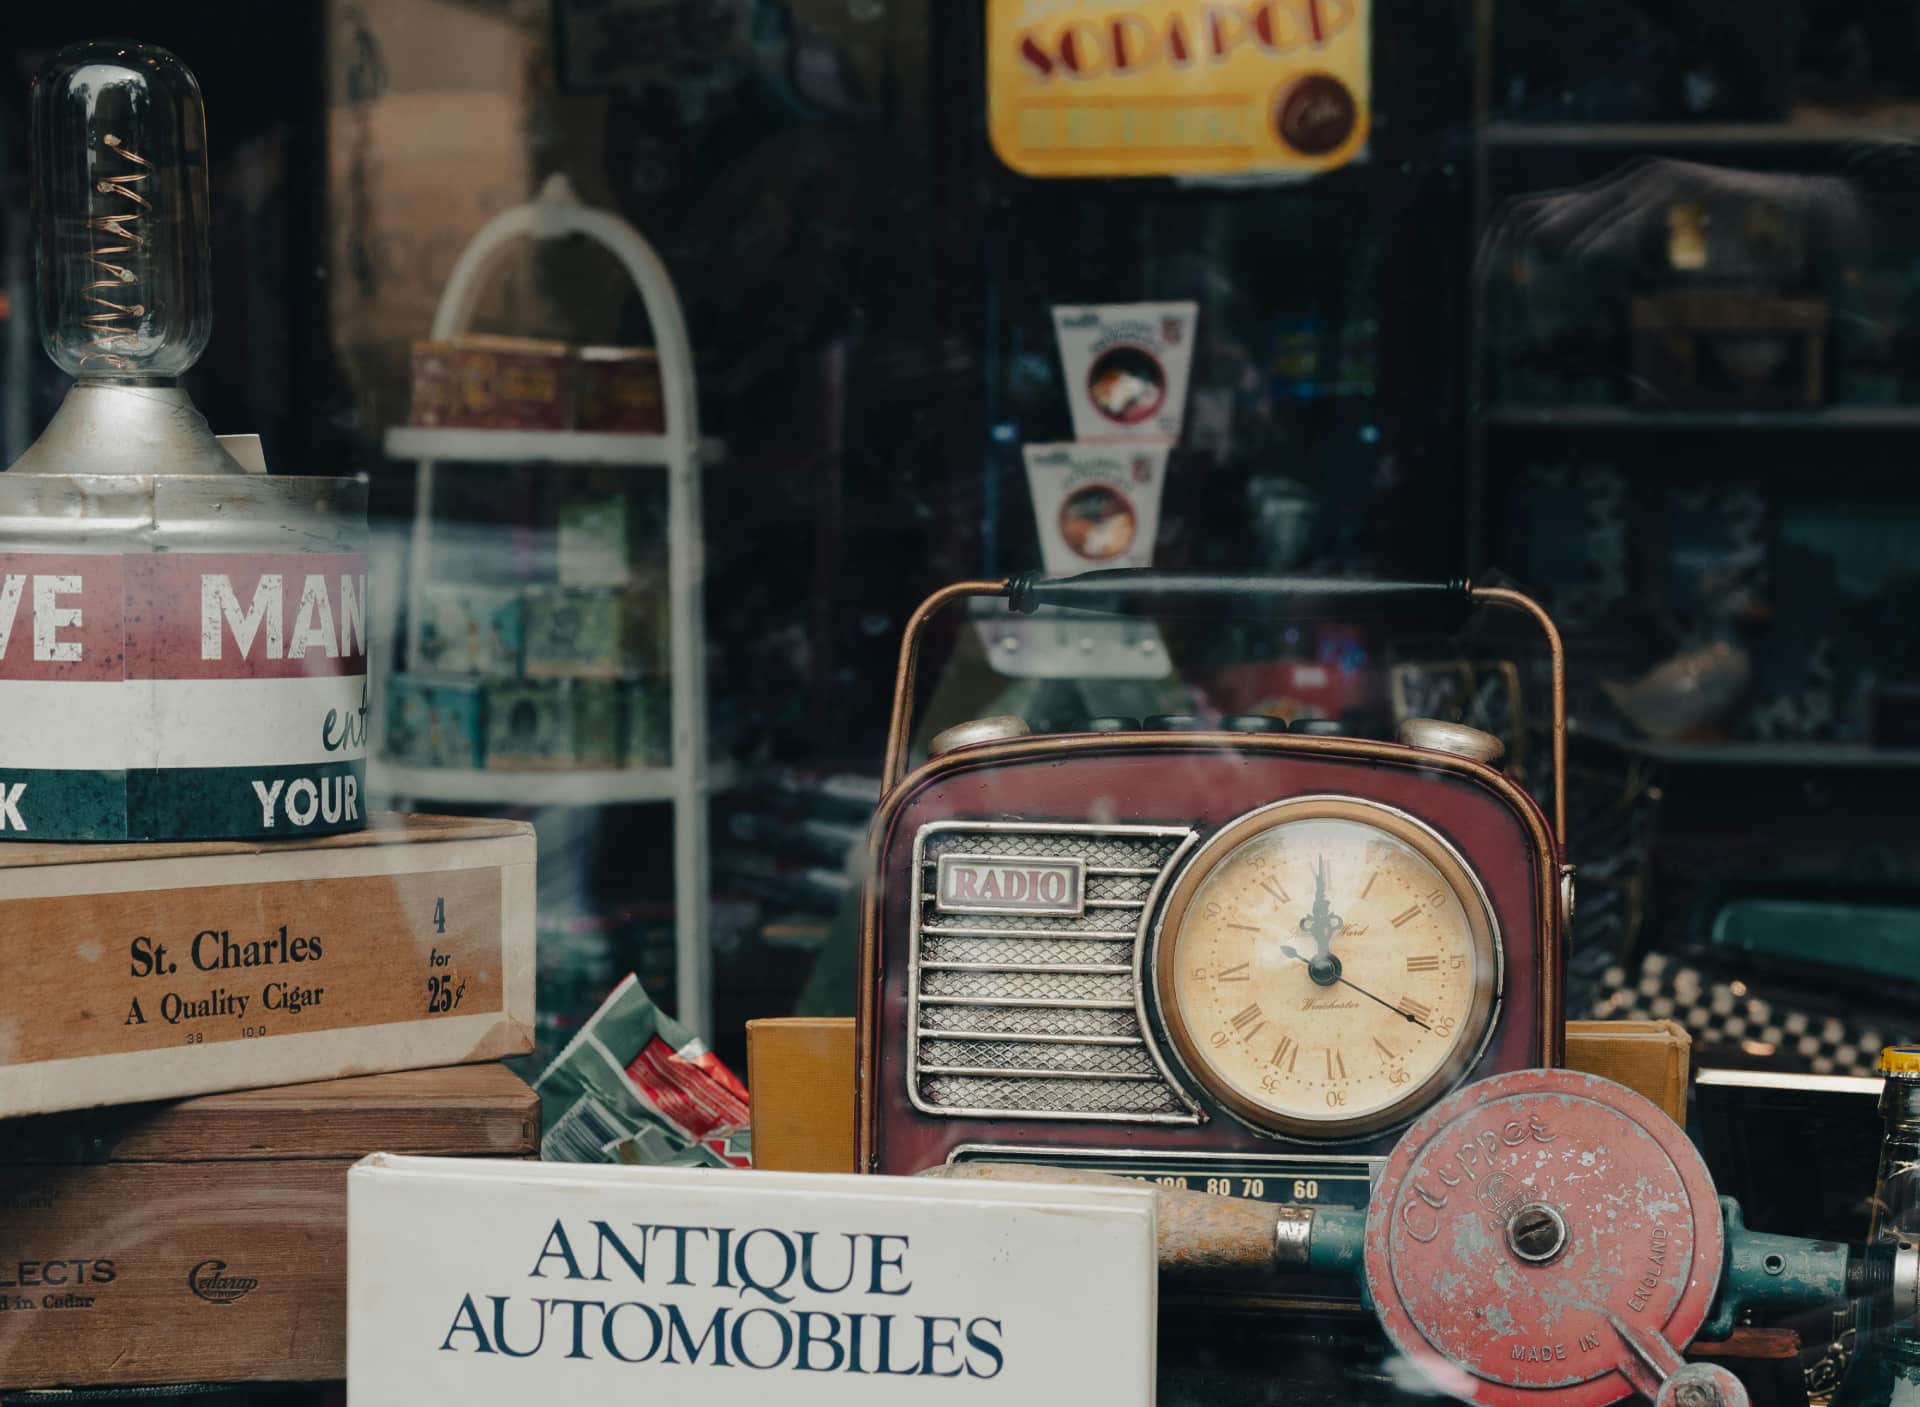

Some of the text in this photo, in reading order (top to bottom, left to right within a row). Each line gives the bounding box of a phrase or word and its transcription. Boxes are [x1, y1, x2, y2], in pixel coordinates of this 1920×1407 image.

[252, 775, 359, 828] YOUR
[953, 868, 1067, 904] RADIO
[433, 897, 446, 934] 4
[131, 926, 323, 977] St. Charles
[429, 948, 451, 967] for
[124, 982, 324, 1025] A Quality Cigar
[1207, 1178, 1231, 1196] 80
[1242, 1178, 1264, 1198] 70
[1293, 1180, 1318, 1199] 60
[528, 1218, 913, 1304] ANTIQUE
[1511, 1227, 1668, 1362] MADE IN ENGLAND
[439, 1293, 1004, 1379] AUTOMOBILES
